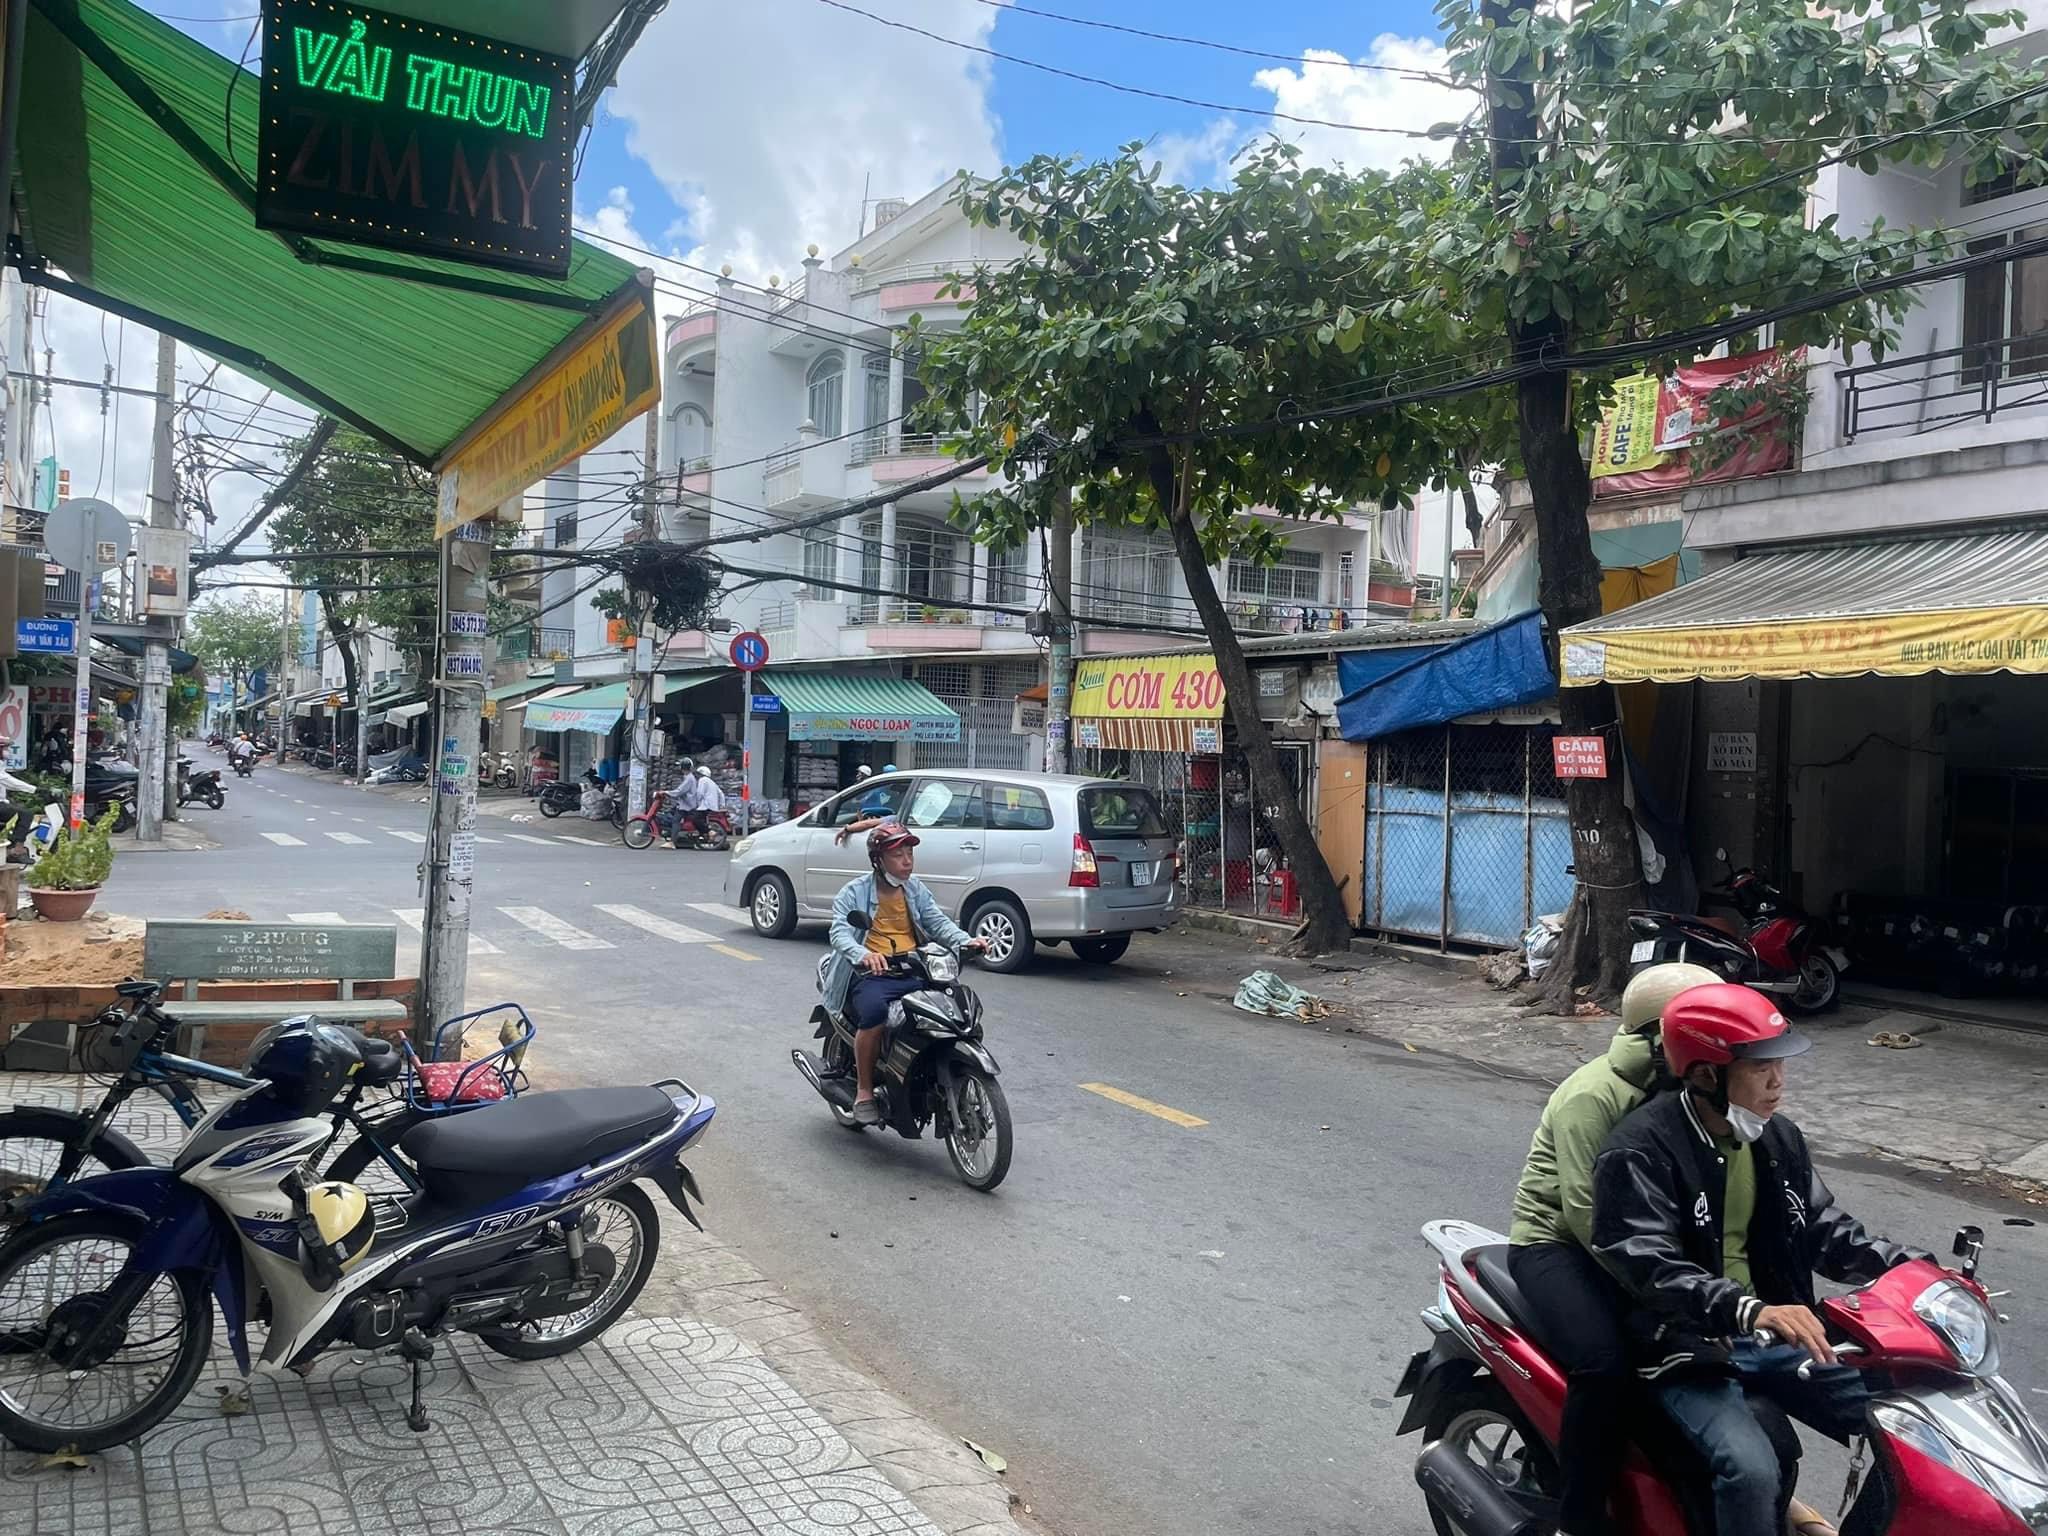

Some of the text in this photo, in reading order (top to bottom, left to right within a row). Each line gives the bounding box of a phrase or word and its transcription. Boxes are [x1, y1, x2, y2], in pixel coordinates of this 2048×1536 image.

[294, 19, 551, 139] VẢI THUN
[1610, 423, 1631, 466] CAFE
[26, 622, 59, 632] ĐƯỜNG
[1901, 642, 1924, 661] MUA
[1107, 666, 1165, 710] CƠM
[849, 719, 879, 733] NGỌC
[882, 719, 911, 730] LOAN
[1559, 737, 1598, 752] CẤM
[1578, 752, 1603, 764] RÁC
[253, 1210, 284, 1220] SYM
[471, 1206, 540, 1240] 50
